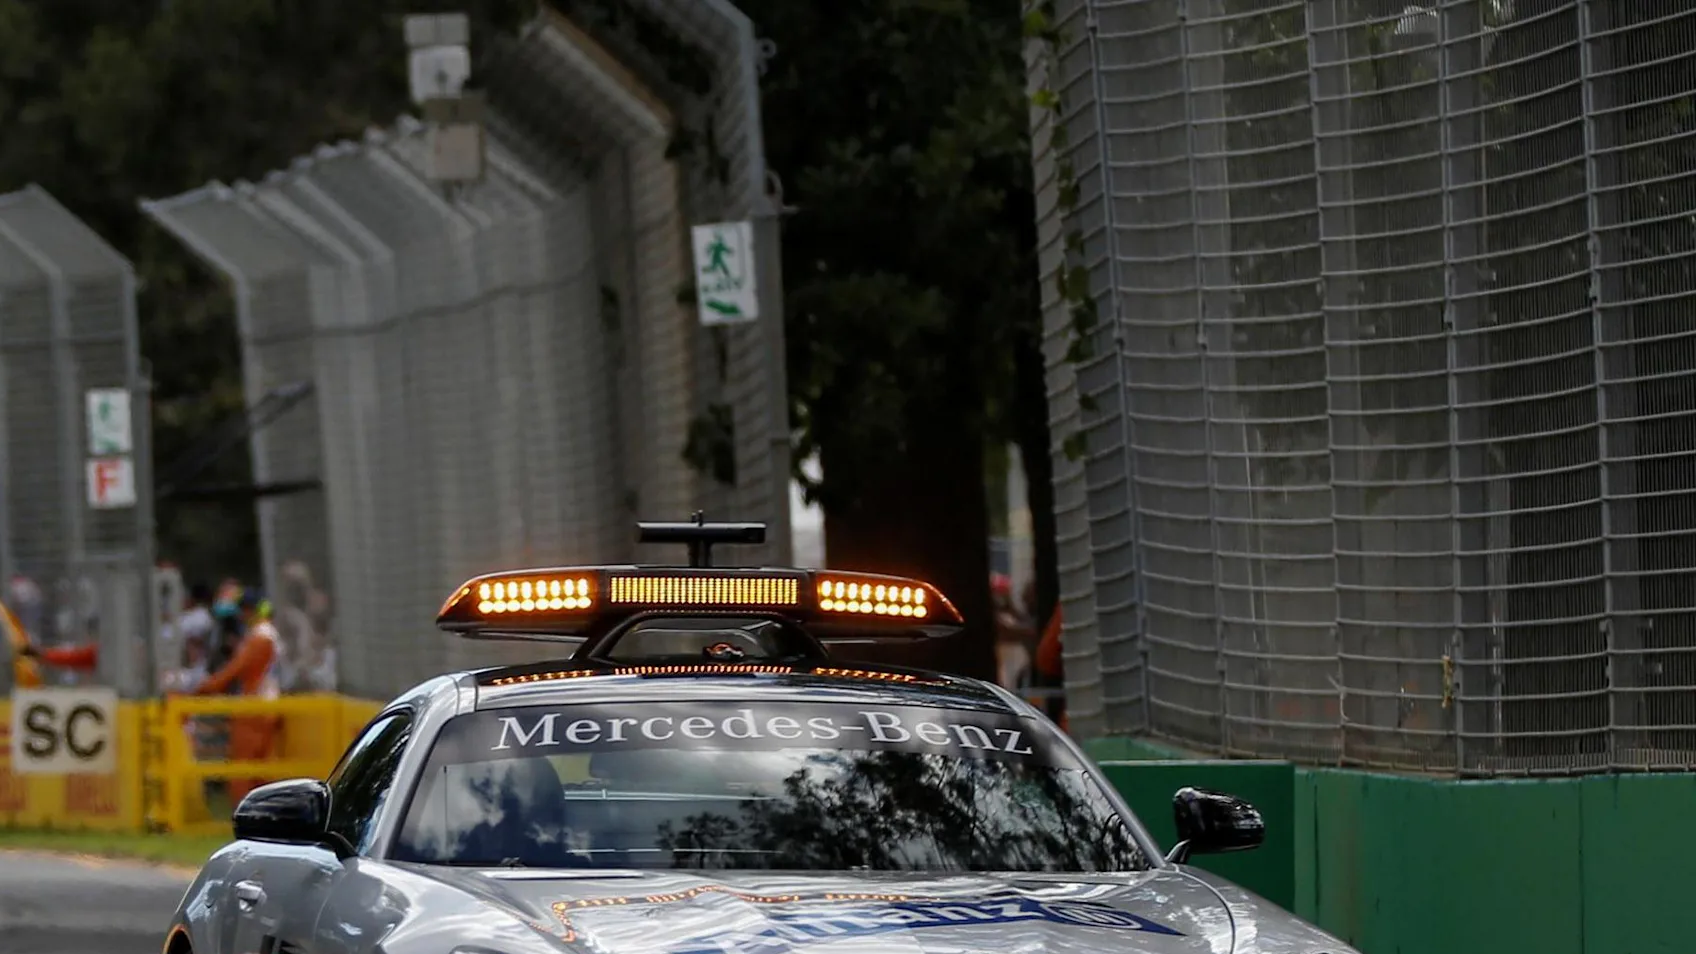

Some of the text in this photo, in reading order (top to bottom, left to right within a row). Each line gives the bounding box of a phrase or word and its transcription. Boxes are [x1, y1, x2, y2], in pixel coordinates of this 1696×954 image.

[94, 459, 121, 502] F
[22, 703, 105, 760] SC
[490, 708, 1033, 756] Mercedes-Benz
